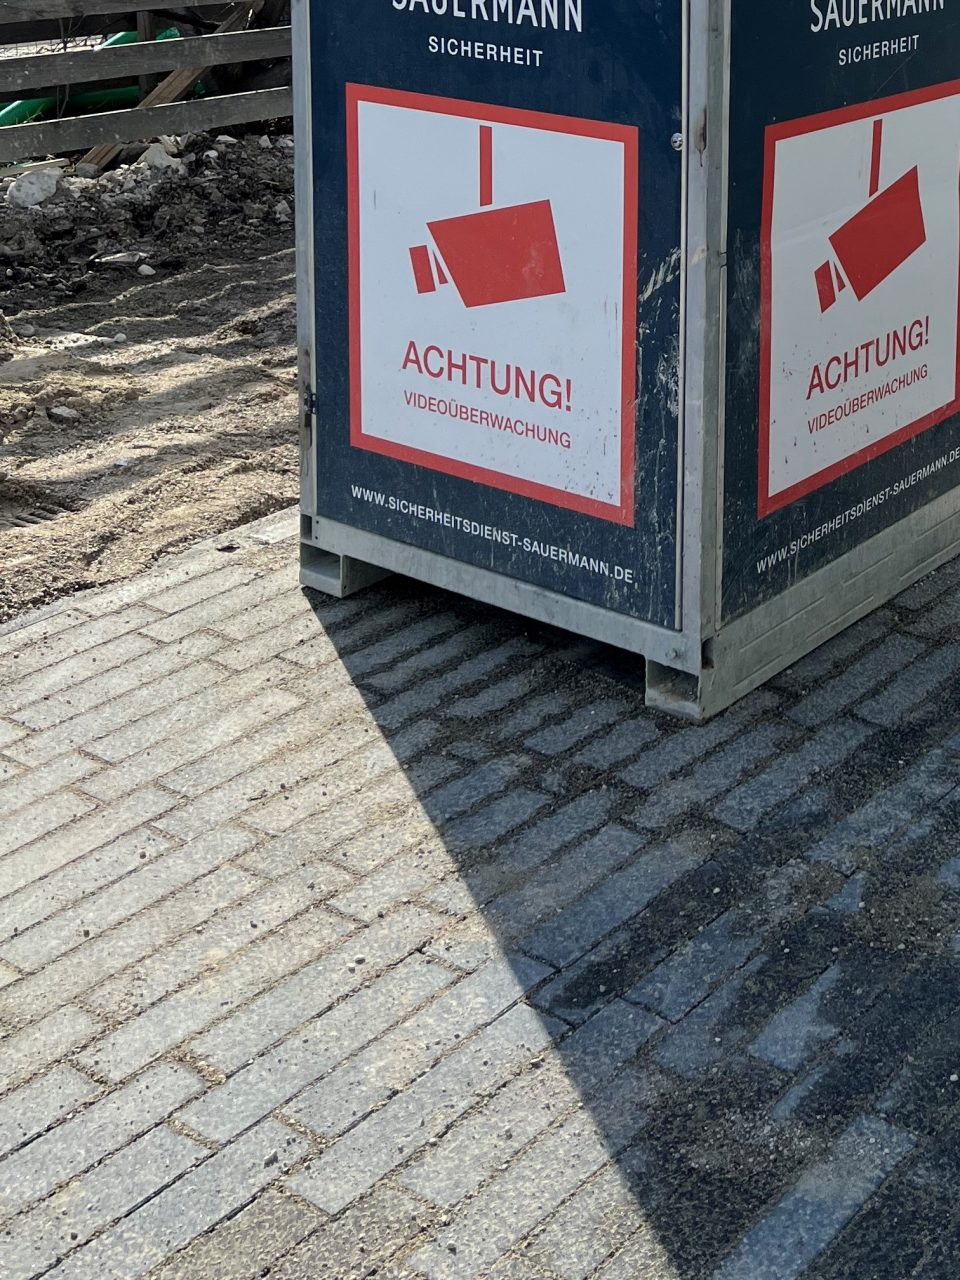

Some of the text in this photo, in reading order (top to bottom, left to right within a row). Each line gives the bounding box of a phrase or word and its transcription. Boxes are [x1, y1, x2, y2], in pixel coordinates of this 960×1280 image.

[428, 35, 544, 67] SICHERHEIT
[838, 34, 920, 66] SICHERHEIT
[402, 340, 573, 412] ACHTUNG!
[806, 316, 930, 400] ACHTUNG!
[404, 390, 572, 449] VIDEOÜBERWACHUNG
[807, 364, 929, 434] VIDEOÜBERWACHUNG
[351, 484, 634, 584] WWW.SICHERHEITSDIENST-SAUERMANN.DE
[756, 446, 960, 575] WWW.SICHERHEITSDIENST-SAUERMANN.DE
